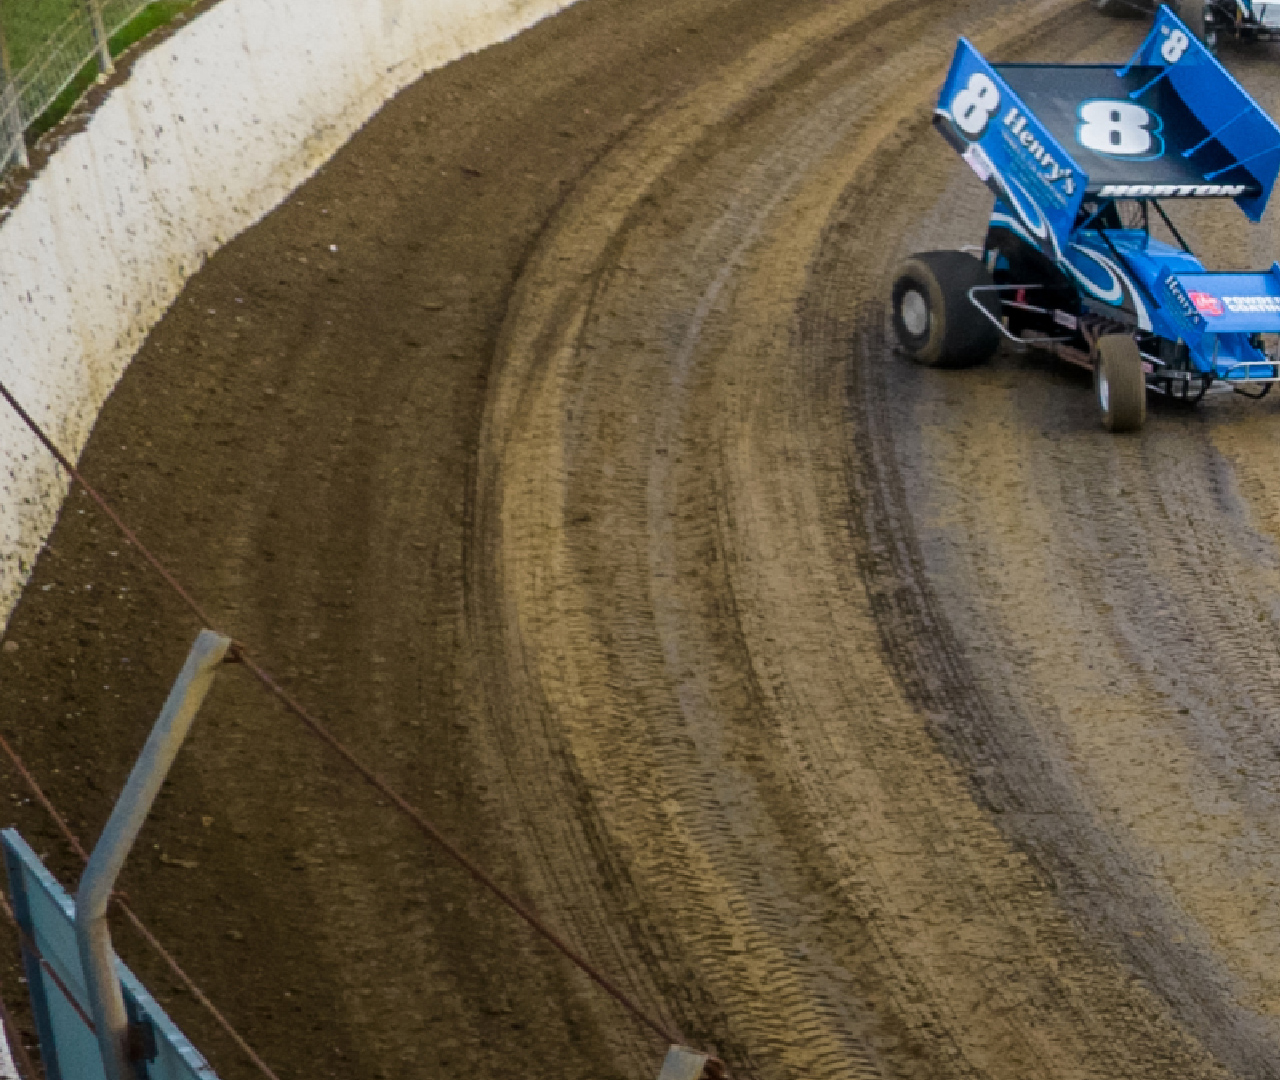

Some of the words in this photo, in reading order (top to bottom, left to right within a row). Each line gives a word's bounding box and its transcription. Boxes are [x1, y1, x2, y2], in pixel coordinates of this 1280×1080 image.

[1161, 28, 1190, 64] 8
[952, 72, 1000, 137] 8
[1078, 99, 1156, 157] 8
[1003, 107, 1074, 195] Henry's
